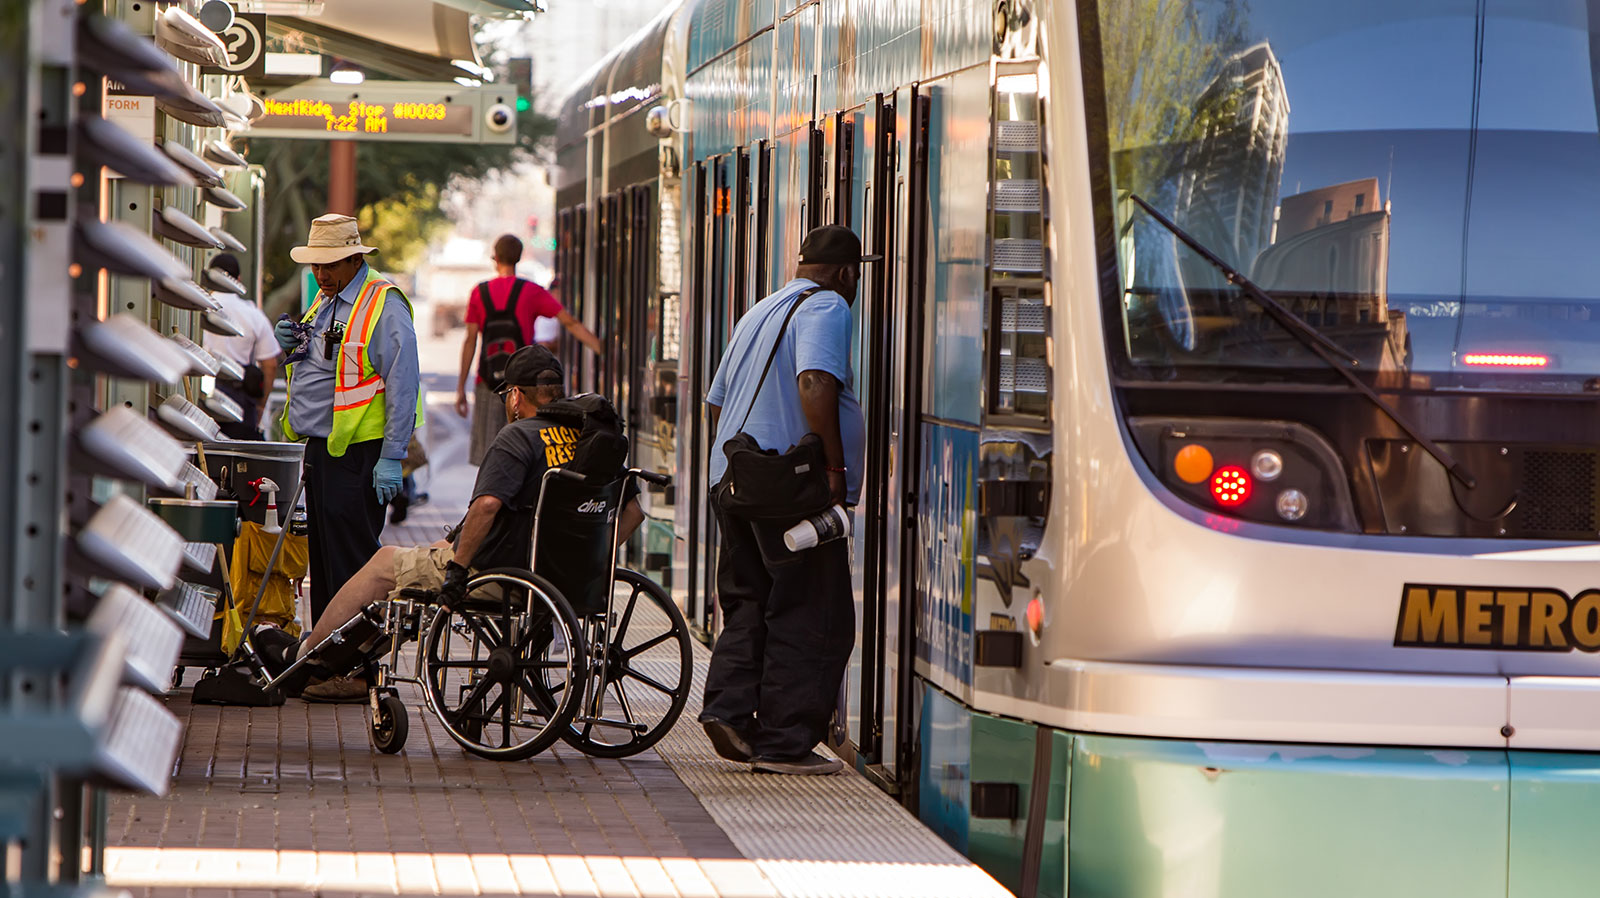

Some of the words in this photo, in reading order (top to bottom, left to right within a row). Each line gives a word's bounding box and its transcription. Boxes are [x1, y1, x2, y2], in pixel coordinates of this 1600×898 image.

[106, 99, 139, 110] FORM
[264, 99, 333, 117] NextRide
[349, 101, 386, 117] Stop
[393, 102, 446, 120] #10033
[325, 114, 358, 132] 7:22
[365, 116, 388, 133] AM
[1401, 587, 1600, 648] METRO
